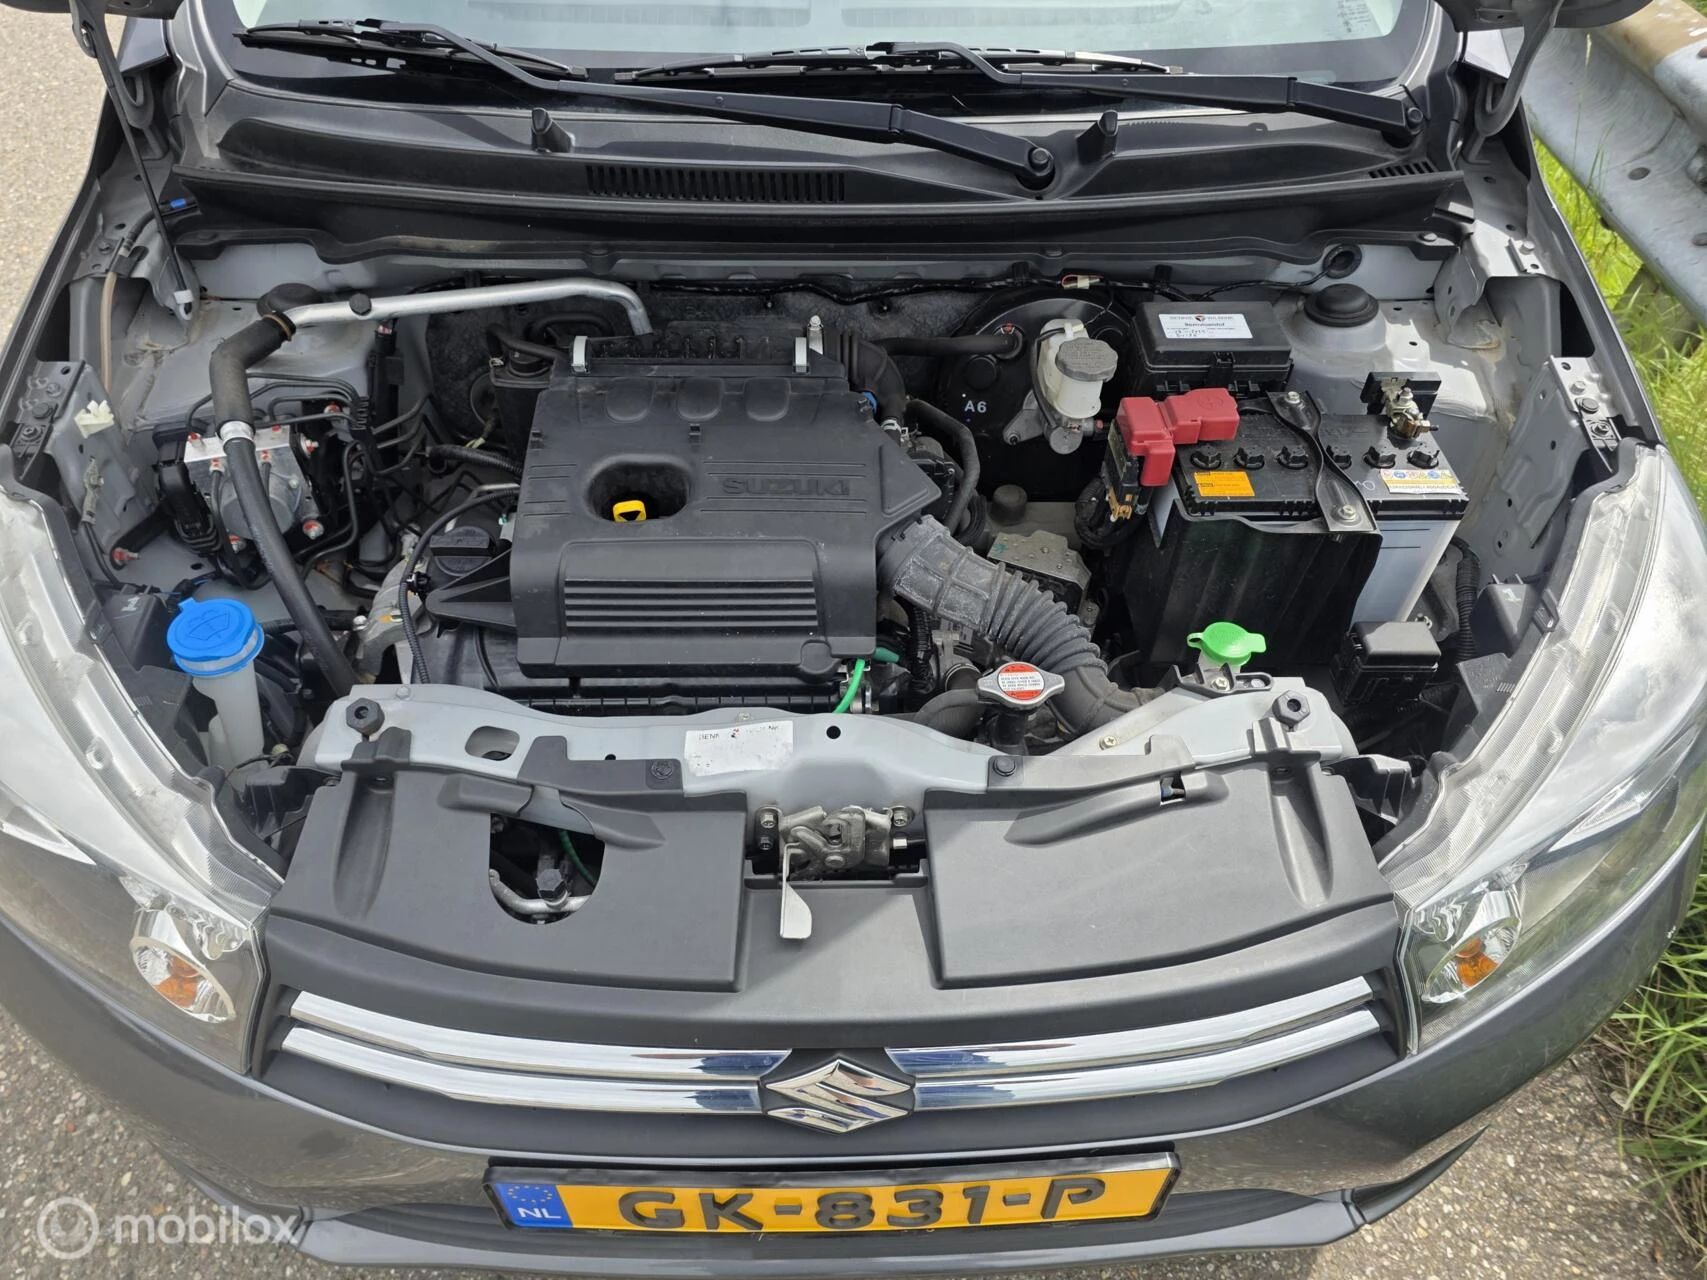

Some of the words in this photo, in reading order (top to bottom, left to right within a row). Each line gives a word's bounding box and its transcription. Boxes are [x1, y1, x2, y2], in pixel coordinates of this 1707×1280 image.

[964, 400, 987, 413] A6
[721, 477, 850, 496] SUZUKI
[618, 1177, 1106, 1231] GK-831-P
[517, 1207, 562, 1219] NL
